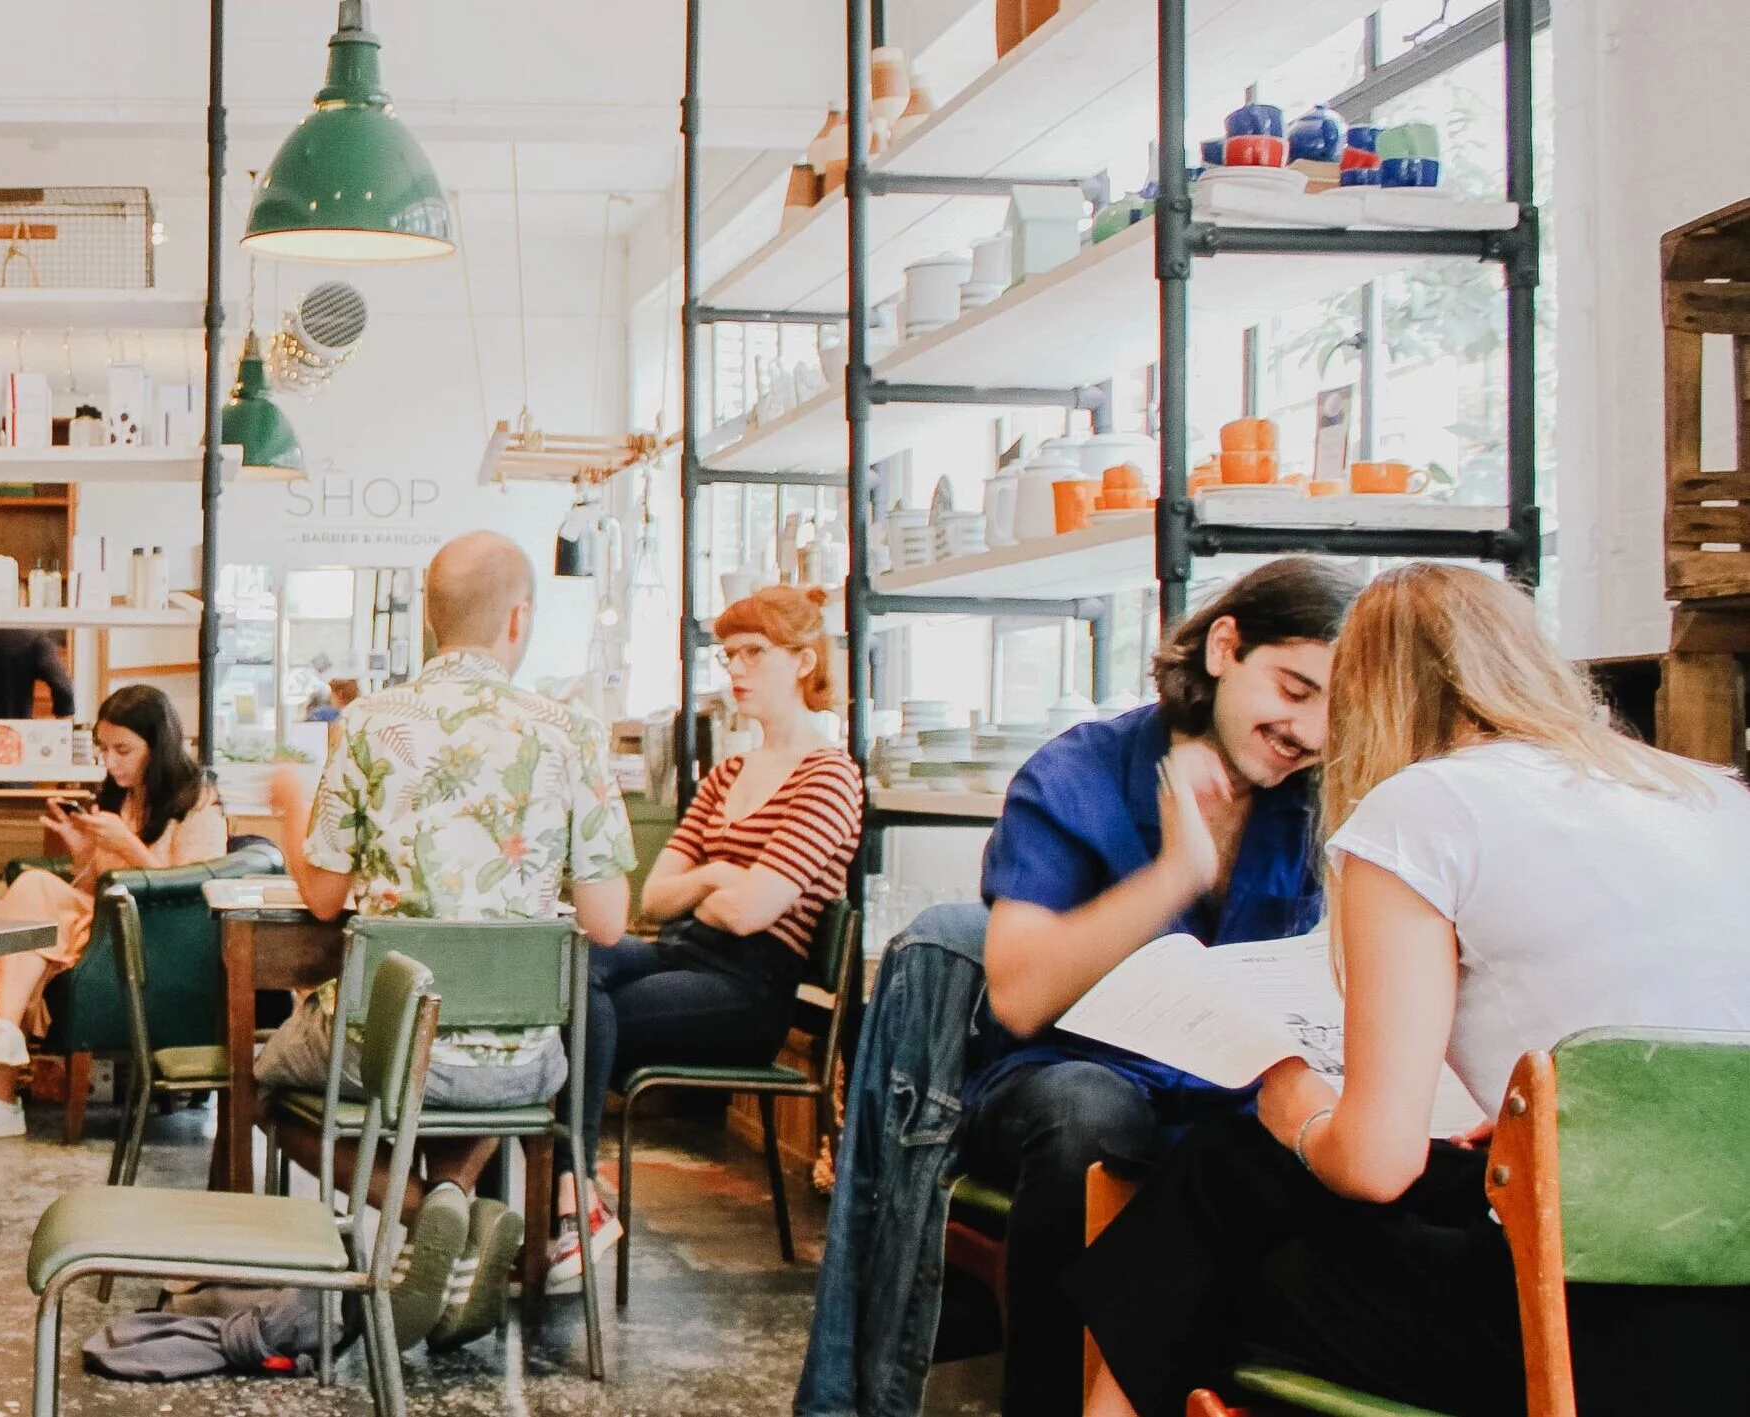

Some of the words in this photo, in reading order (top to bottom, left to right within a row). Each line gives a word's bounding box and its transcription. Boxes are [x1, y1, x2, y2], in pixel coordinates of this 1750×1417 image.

[284, 477, 440, 519] SHOP
[301, 532, 359, 544] BARBER
[363, 533, 372, 544] &
[375, 533, 443, 546] PARLOUR
